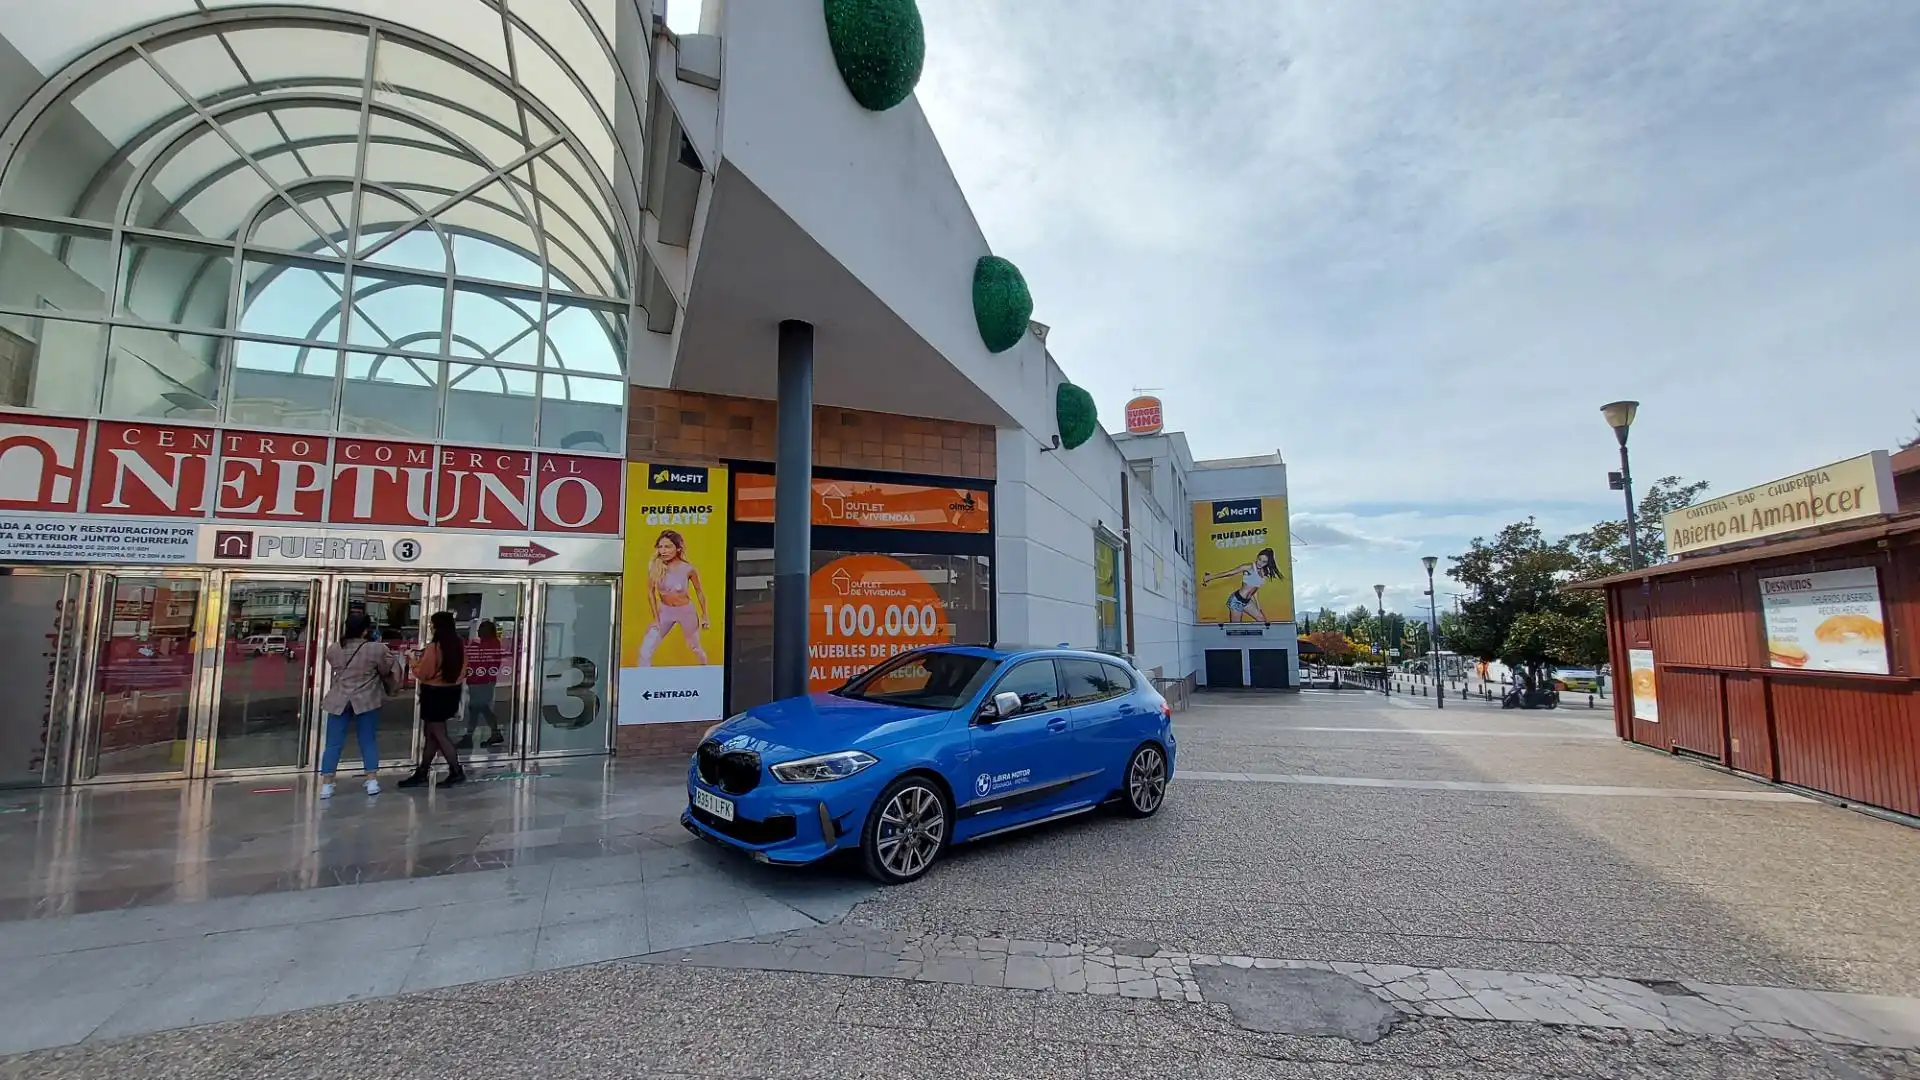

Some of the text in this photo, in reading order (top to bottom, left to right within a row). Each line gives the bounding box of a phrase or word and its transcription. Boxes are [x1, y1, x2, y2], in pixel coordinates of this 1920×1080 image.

[1127, 408, 1160, 417] BURGER
[1128, 415, 1160, 427] KING
[122, 428, 582, 474] CENTRO COMERCIAL
[670, 473, 703, 484] McFIT
[101, 448, 603, 528] NEPTUNO
[1737, 492, 1757, 508] BAR
[641, 504, 713, 515] PRUÉBANOS
[846, 502, 885, 511] OUTLET
[1230, 507, 1258, 516] McFIT
[646, 512, 709, 526] GRATIS
[846, 511, 916, 522] DE VIVIENDAS
[80, 525, 168, 535] RESTAURACIÓN
[172, 528, 194, 536] POR
[1210, 527, 1268, 541] PRUÉBANOS
[17, 533, 78, 541] EXTERIOR
[81, 534, 120, 543] JUNTO
[124, 536, 189, 545] CHURRERÍA
[1215, 535, 1265, 549] GRATIS
[257, 535, 414, 561] PUERTA 3
[850, 581, 882, 589] OUTLET
[863, 589, 907, 597] VIVIENDAS
[823, 603, 937, 637] 100.000
[870, 643, 886, 657] DE
[809, 665, 827, 680] AL
[542, 656, 601, 731] 3
[654, 689, 699, 699] ENTRADA
